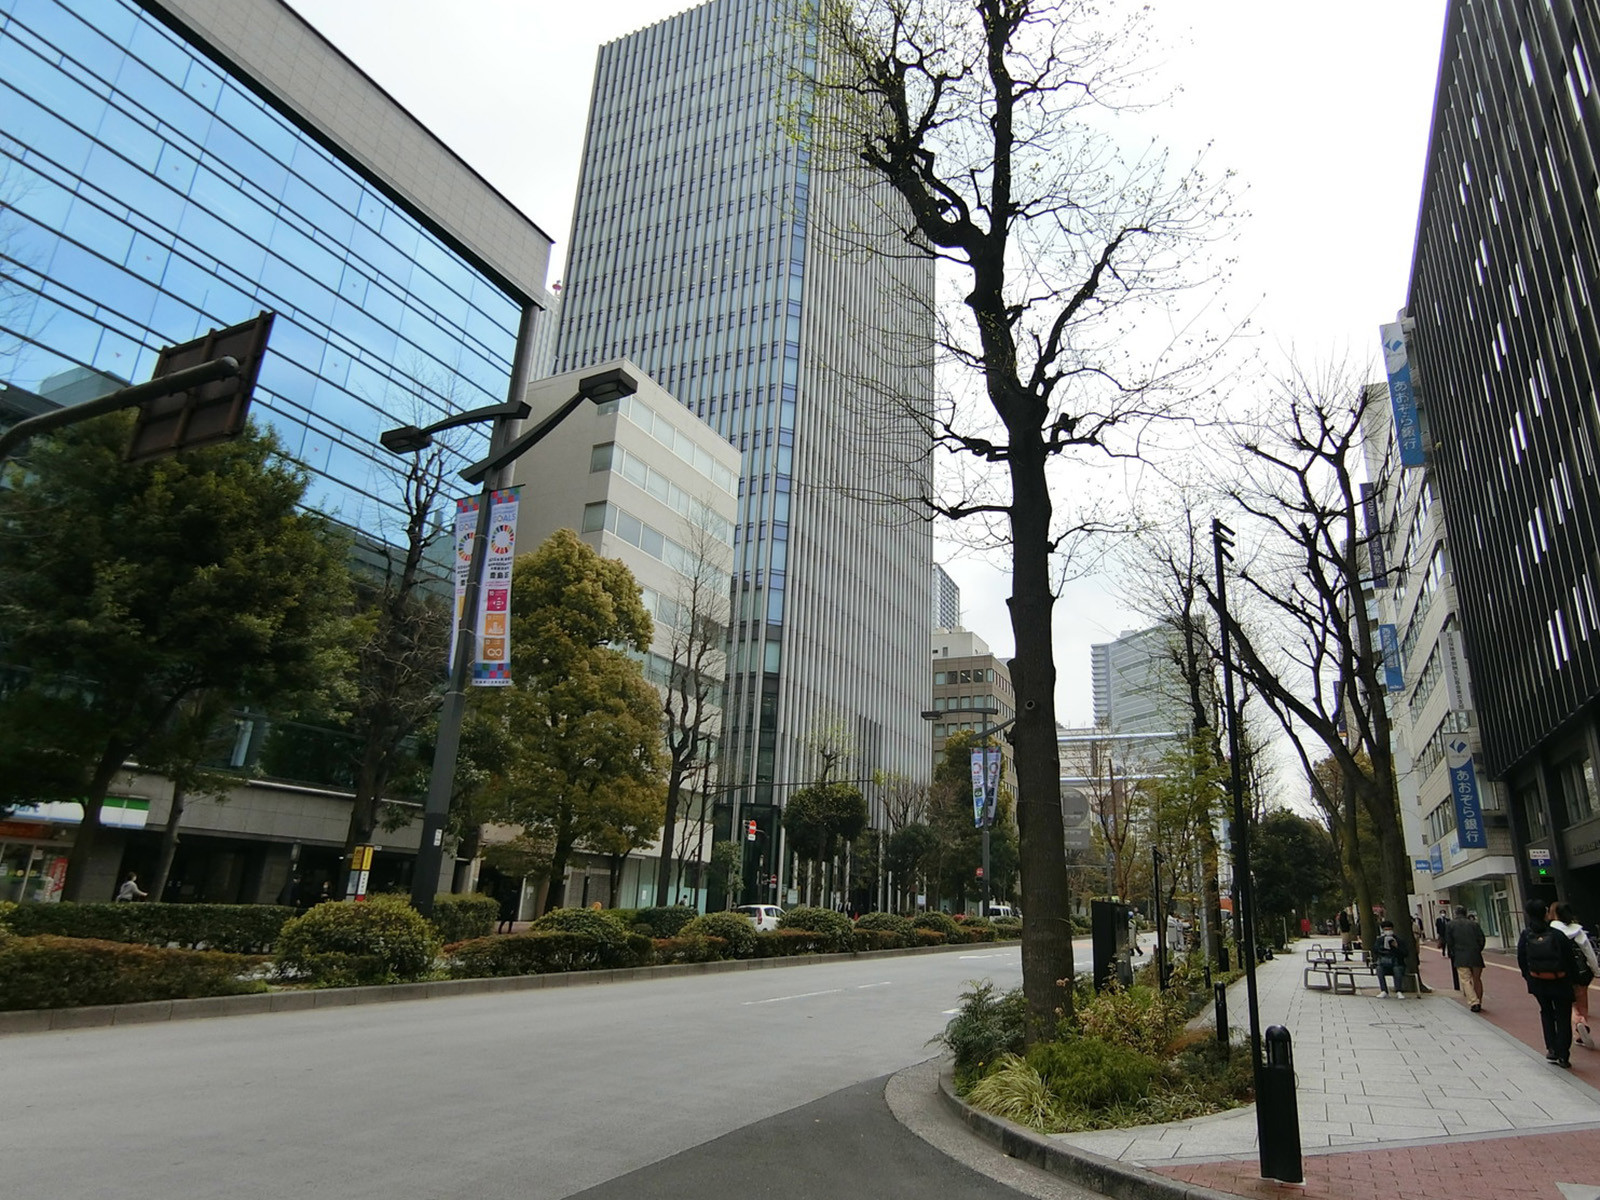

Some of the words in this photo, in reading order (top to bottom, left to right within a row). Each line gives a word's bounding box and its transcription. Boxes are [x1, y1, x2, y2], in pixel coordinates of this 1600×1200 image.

[1393, 380, 1417, 450] あおぞら銀行
[1366, 489, 1376, 517] MZUHO
[1456, 769, 1479, 843] あおぞら銀行
[1537, 859, 1545, 867] P
